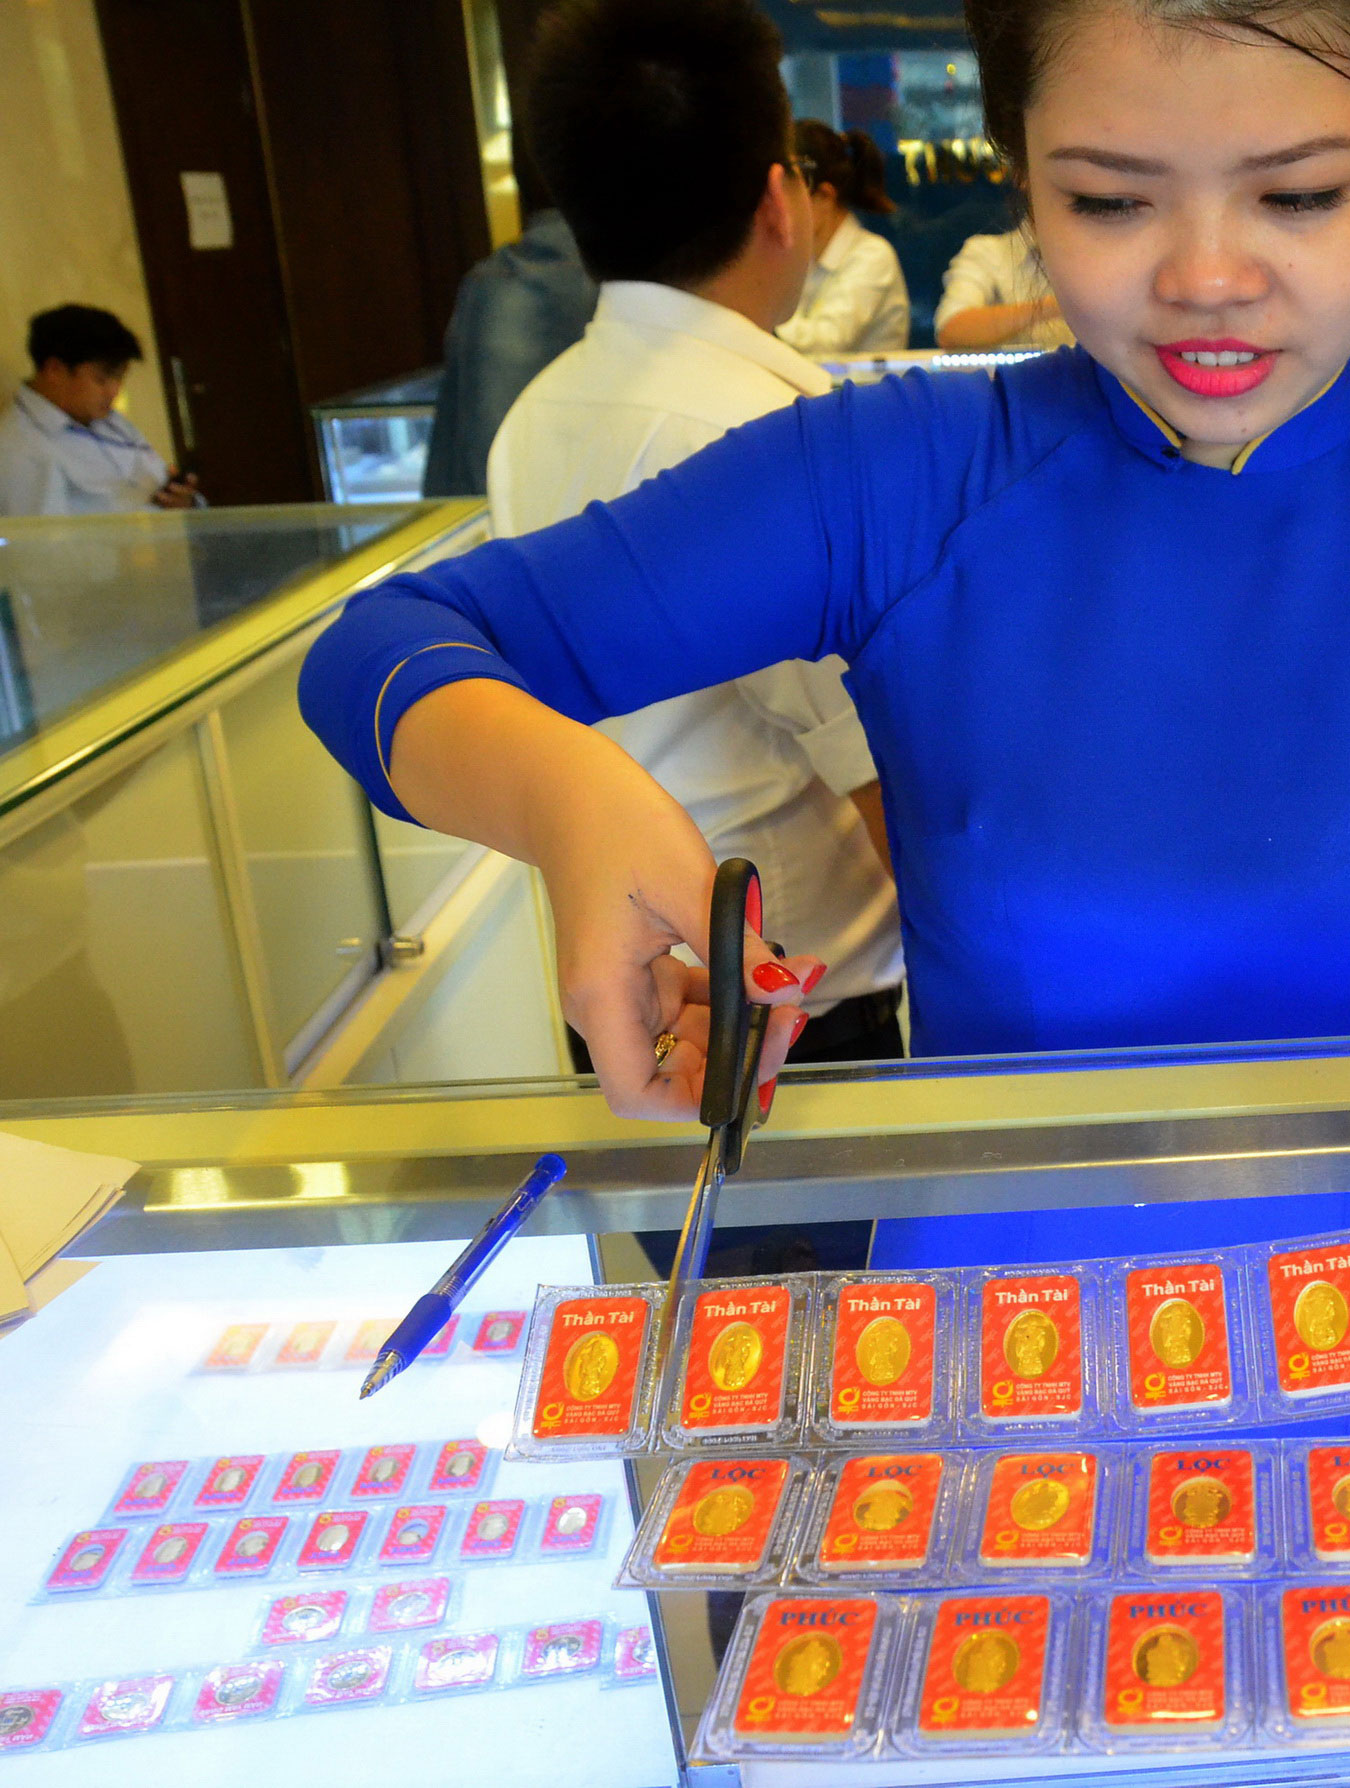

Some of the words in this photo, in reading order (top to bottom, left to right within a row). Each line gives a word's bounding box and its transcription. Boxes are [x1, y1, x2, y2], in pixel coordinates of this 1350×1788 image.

[1280, 1259, 1323, 1278] Thần
[995, 1289, 1039, 1304] Thần
[1041, 1288, 1068, 1302] Tài
[1142, 1281, 1185, 1297] Thần
[1188, 1279, 1214, 1293] Tài
[704, 1301, 747, 1317] Thần
[749, 1301, 776, 1314] Tài
[848, 1297, 890, 1311] Thần
[894, 1298, 921, 1310] Tài
[563, 1310, 605, 1326] Thần
[608, 1312, 634, 1324] Tài
[867, 1463, 923, 1478] LỘC
[1020, 1462, 1076, 1478] LỘC
[1176, 1457, 1231, 1472] LỘC
[710, 1466, 766, 1482] LỘC
[779, 1608, 861, 1626] PHÚC
[953, 1607, 1035, 1626] PHÚC
[1129, 1603, 1208, 1619] PHÚC
